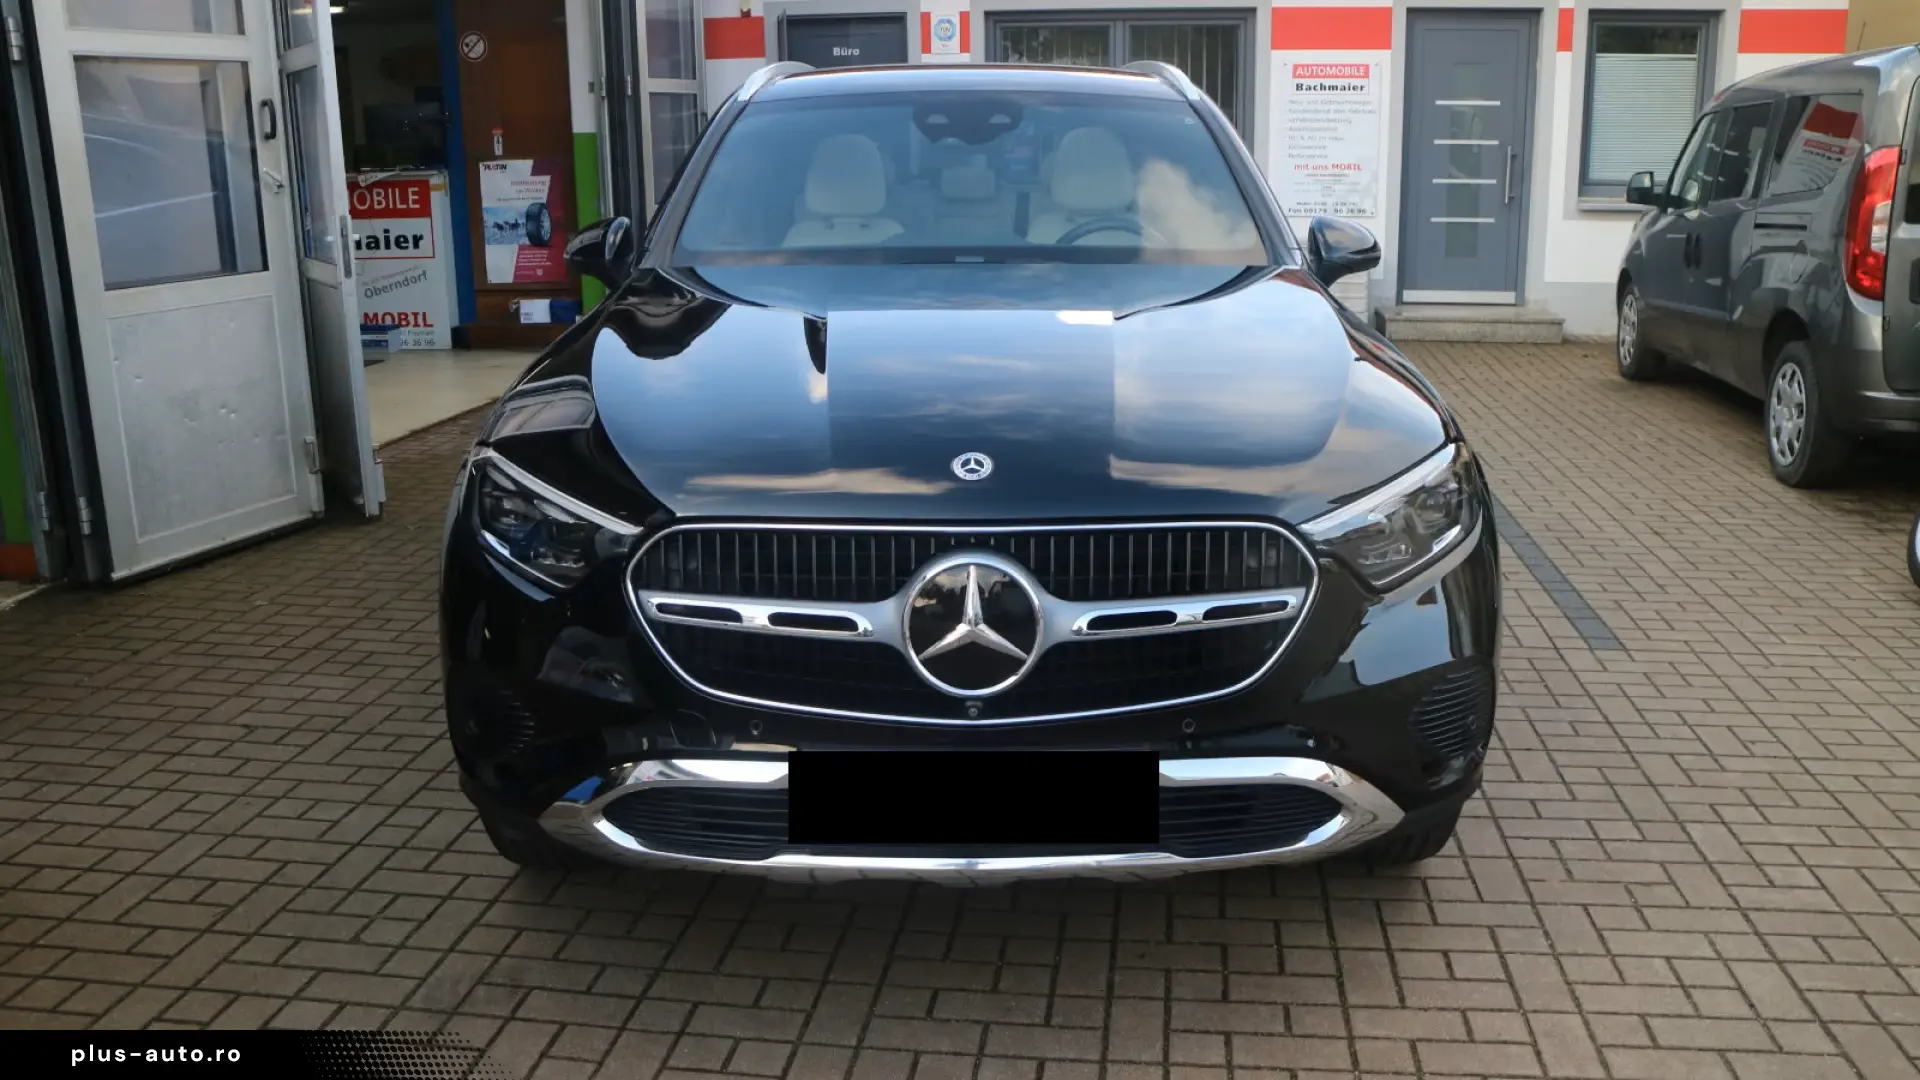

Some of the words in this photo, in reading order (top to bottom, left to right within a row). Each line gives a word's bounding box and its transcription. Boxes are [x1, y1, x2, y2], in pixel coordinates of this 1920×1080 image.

[833, 46, 860, 57] Büro
[1294, 65, 1366, 76] AUTOMOBILE
[1295, 82, 1366, 92] Bachmaier
[1294, 163, 1309, 171] mit
[1331, 163, 1362, 171] MOBIL
[349, 186, 421, 210] OBILE
[363, 269, 428, 299] Oberndorf
[363, 311, 434, 328] MOBIL
